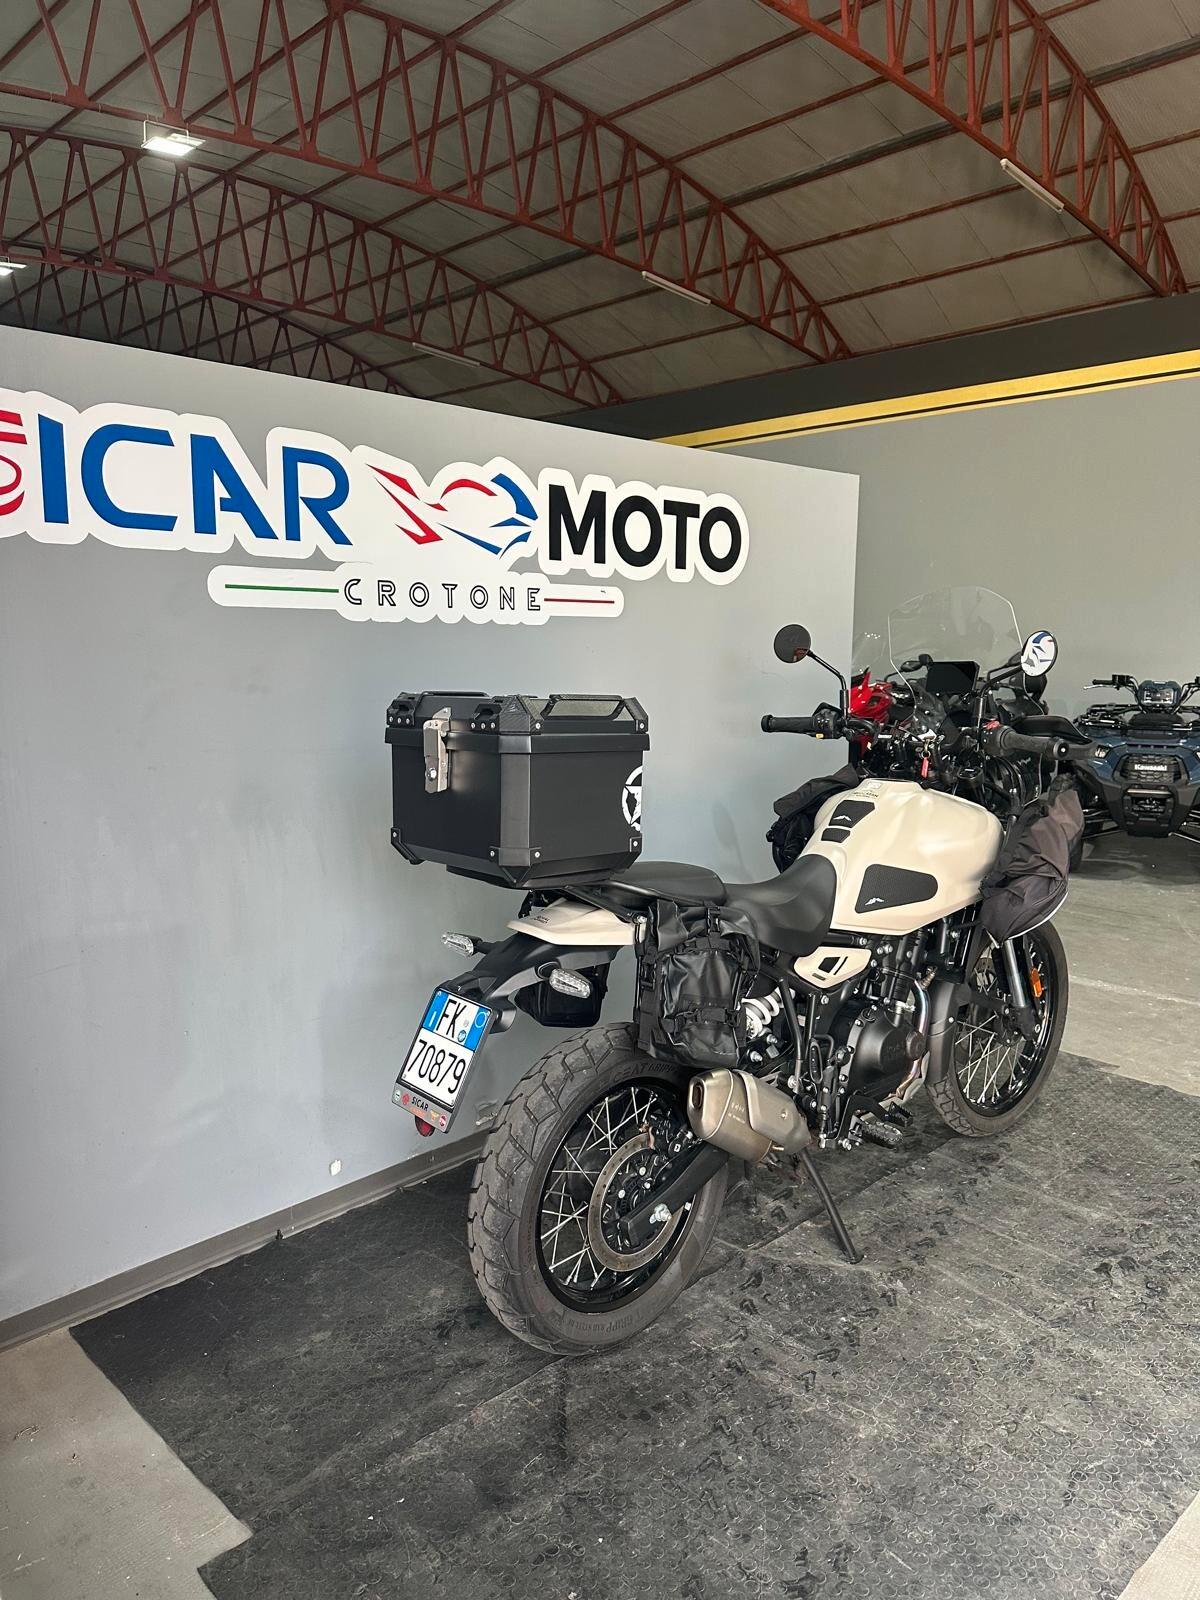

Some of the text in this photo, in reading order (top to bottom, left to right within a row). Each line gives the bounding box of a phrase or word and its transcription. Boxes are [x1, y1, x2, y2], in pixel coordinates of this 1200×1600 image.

[547, 483, 742, 573] MOTO
[343, 578, 541, 612] CROTONE
[436, 998, 467, 1038] FK
[407, 1039, 467, 1094] 70879
[411, 1096, 429, 1112] SICAR
